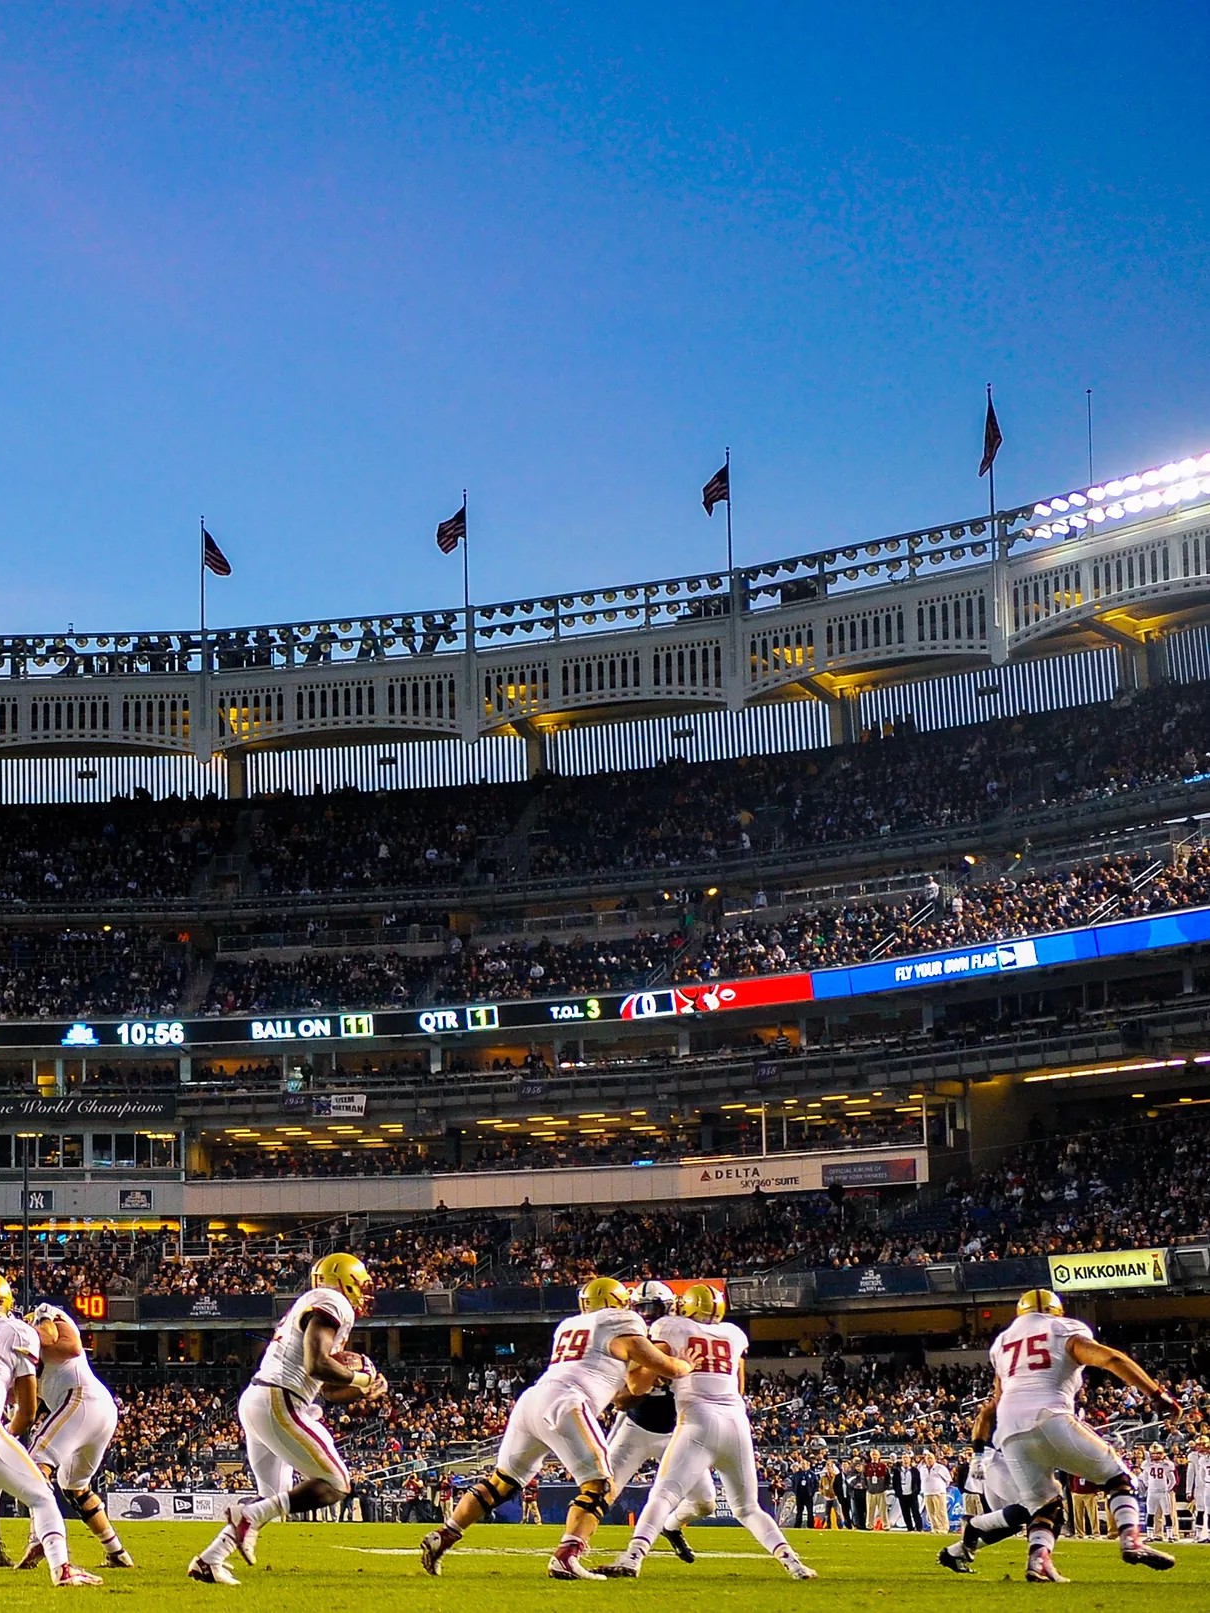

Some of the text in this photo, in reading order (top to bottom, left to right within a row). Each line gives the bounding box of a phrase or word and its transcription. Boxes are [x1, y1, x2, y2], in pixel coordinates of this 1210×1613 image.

[895, 951, 999, 982] FLY YOUR OWN FLAG
[586, 1000, 601, 1019] 3
[252, 1018, 331, 1039] BALL ON
[345, 1017, 368, 1034] 11
[419, 1011, 459, 1032] QTR
[116, 1022, 185, 1045] 10:56
[19, 1099, 75, 1115] World
[77, 1099, 164, 1117] Champions
[715, 1167, 760, 1180] DELTA
[775, 1176, 800, 1186] SUITE
[1073, 1262, 1147, 1279] KIKKOMAN
[76, 1295, 104, 1316] 40
[1001, 1333, 1052, 1377] 75
[1149, 1467, 1164, 1479] 48
